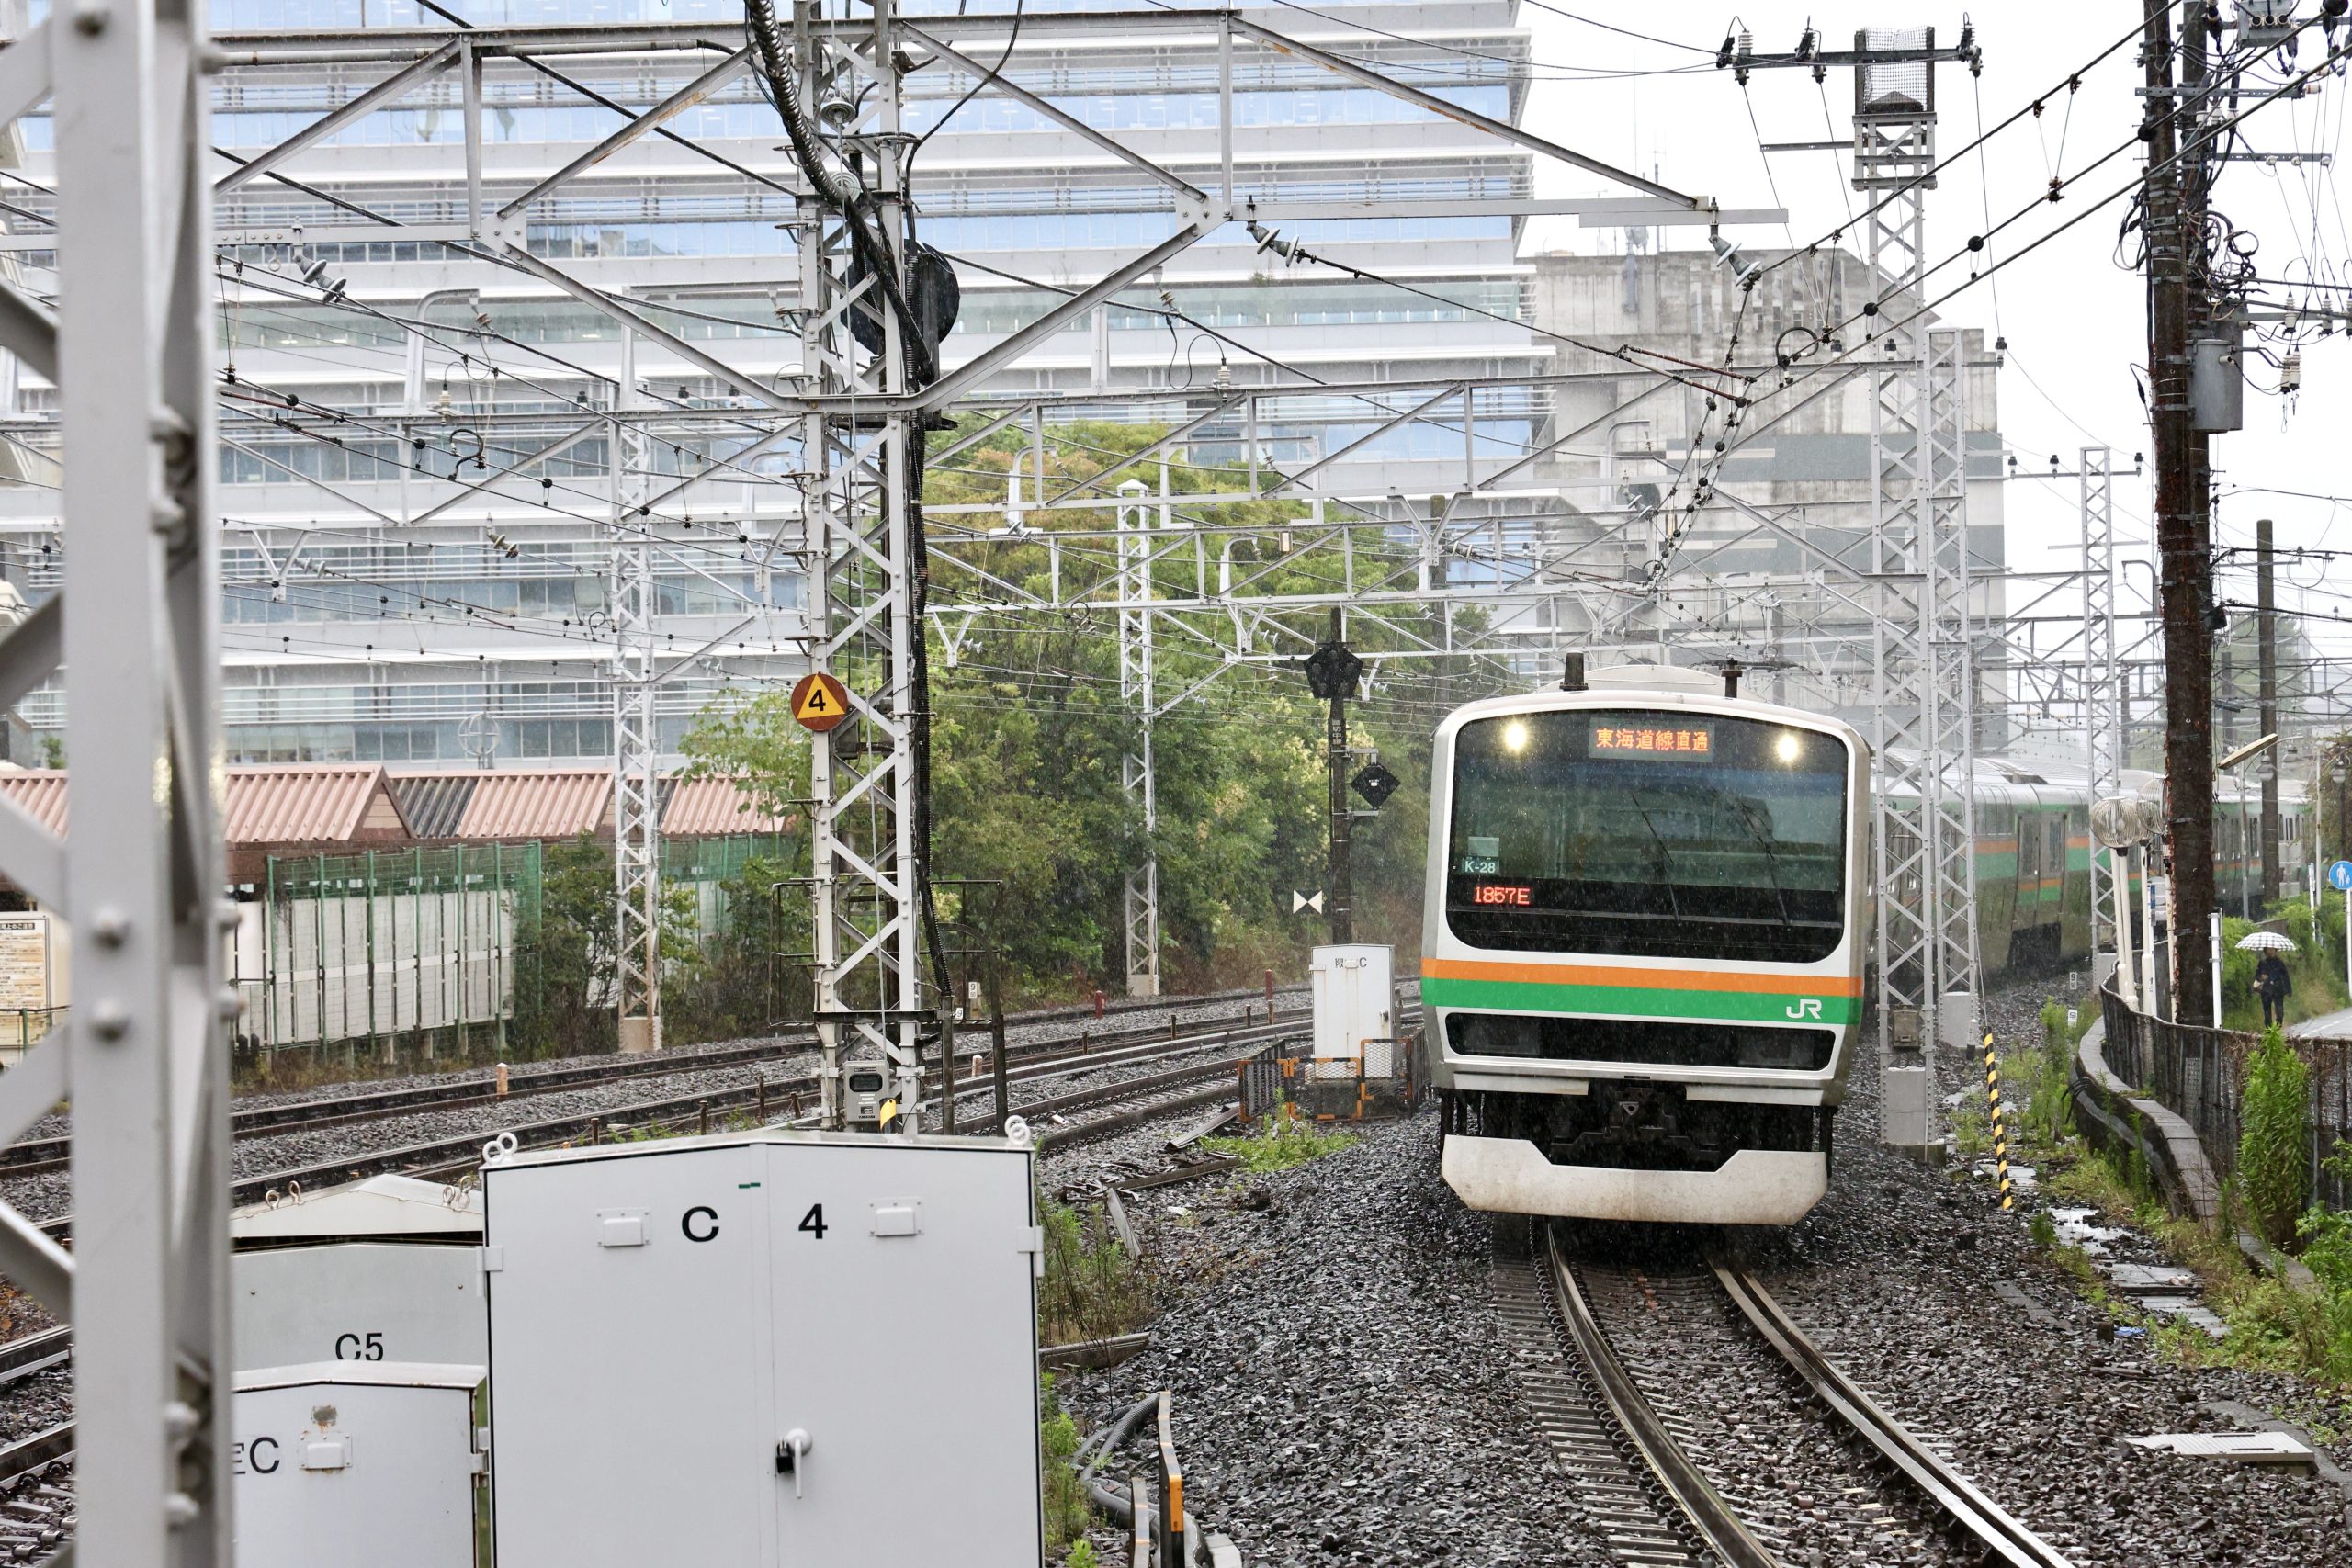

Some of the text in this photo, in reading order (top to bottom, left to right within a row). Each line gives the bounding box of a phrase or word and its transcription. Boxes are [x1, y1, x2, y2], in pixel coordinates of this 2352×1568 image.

[808, 689, 827, 712] 4
[1596, 728, 1709, 752] 東海道線直通
[1464, 861, 1496, 874] K-28
[1475, 886, 1531, 906] 1857E
[1786, 998, 1822, 1020] JR
[681, 1203, 828, 1243] C 4
[335, 1332, 384, 1361] C5
